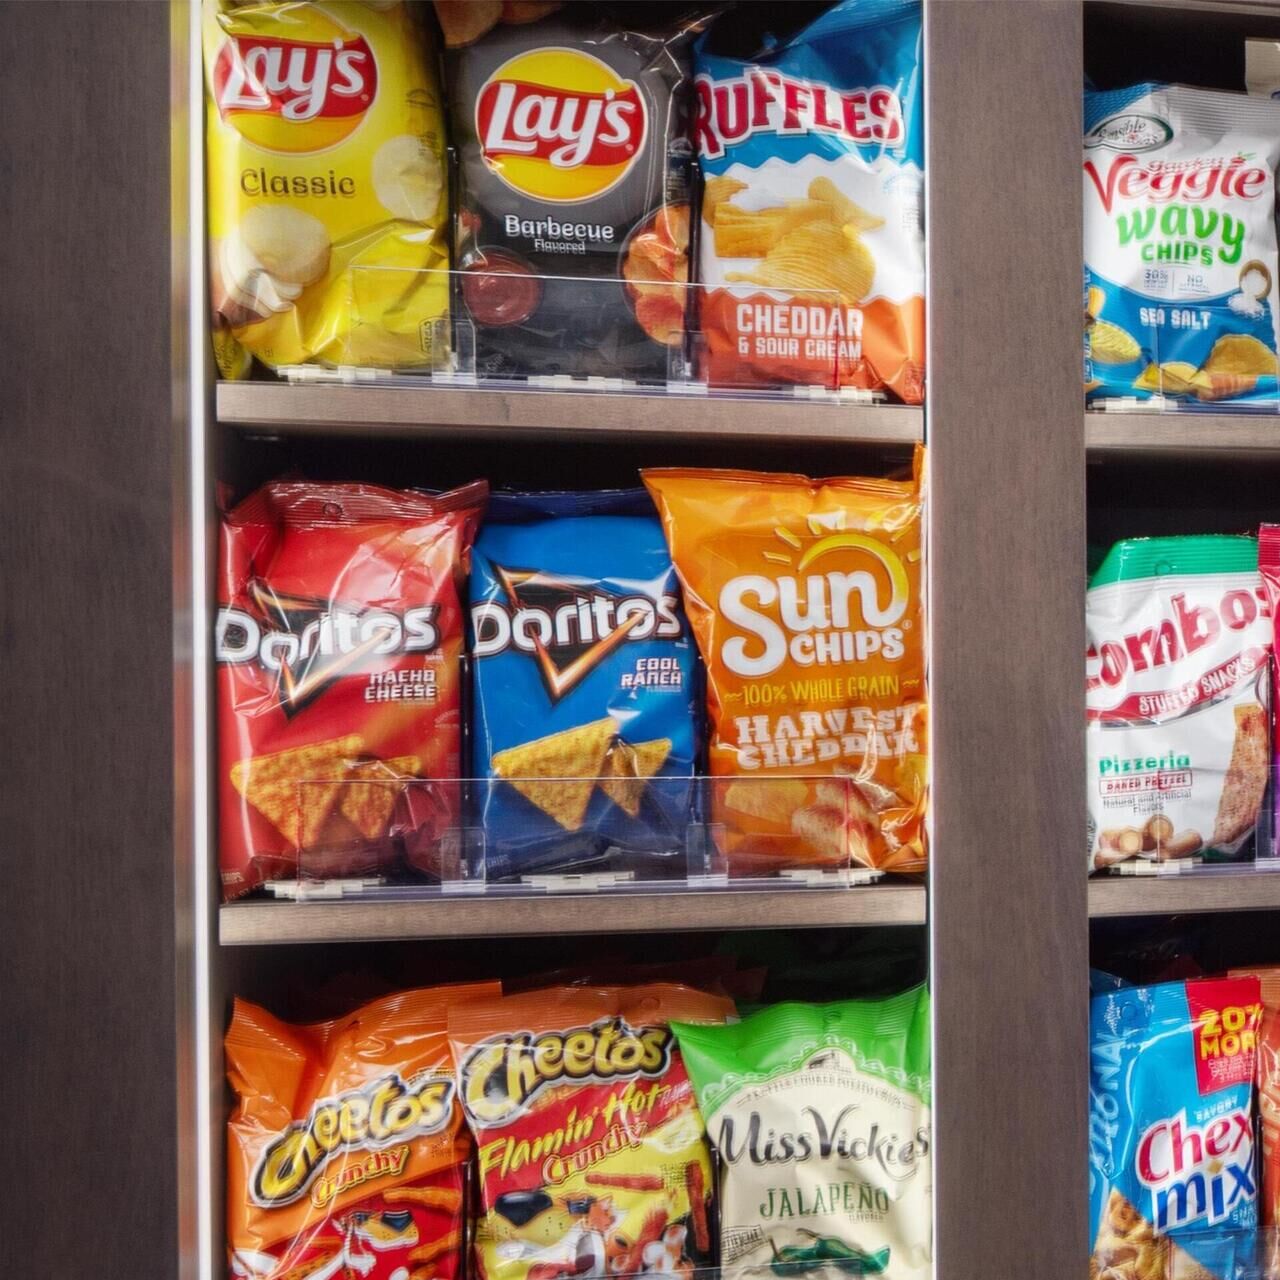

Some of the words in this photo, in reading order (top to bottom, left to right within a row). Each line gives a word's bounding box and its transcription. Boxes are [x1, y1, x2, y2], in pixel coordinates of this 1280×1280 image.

[221, 34, 366, 121] Lay's
[483, 84, 634, 168] Lay's
[695, 72, 903, 154] RUFFLES
[241, 168, 356, 197] Classic
[1083, 153, 1266, 215] Veggie
[504, 213, 614, 241] Barbecue
[1116, 203, 1245, 265] wavy
[1141, 242, 1214, 267] CHIPS
[737, 303, 863, 338] CHEDDAR
[1140, 307, 1165, 326] SEA
[1171, 310, 1211, 330] SALT
[738, 336, 748, 355] &
[756, 338, 799, 357] SOUR
[805, 340, 862, 359] CREAM
[218, 600, 437, 669] Doritos
[472, 596, 682, 656] Doritos
[719, 571, 907, 677] Sun
[636, 657, 680, 672] COOL
[790, 628, 905, 666] CHIPS
[364, 685, 437, 701] CHEESE
[621, 672, 682, 688] RANCH
[743, 684, 787, 707] 100%
[791, 678, 843, 703] WHOLE
[848, 675, 899, 699] GRAIN
[735, 703, 922, 745] HARVEST
[738, 731, 919, 769] CHEDDAR
[1099, 750, 1191, 776] Pizzeria
[463, 1017, 673, 1122] Cheetos
[480, 1105, 600, 1190] Flamin'
[603, 1080, 671, 1126] Hot
[543, 1121, 648, 1184] Crunchy
[717, 1111, 812, 1165] Miss
[1138, 1112, 1254, 1184] Chex
[760, 1181, 889, 1219] JALAPEÑO
[1157, 1163, 1256, 1229] mix
